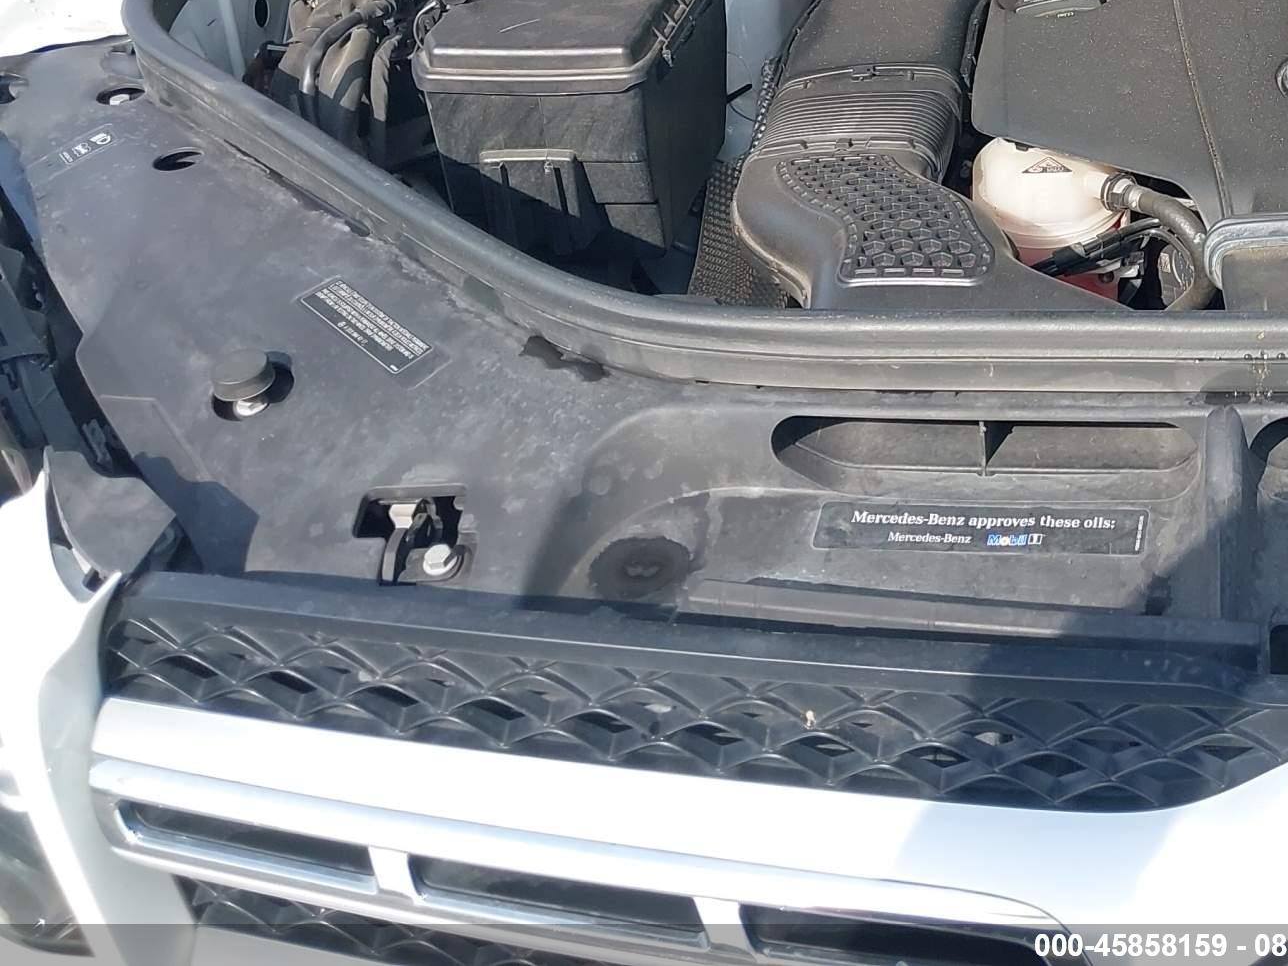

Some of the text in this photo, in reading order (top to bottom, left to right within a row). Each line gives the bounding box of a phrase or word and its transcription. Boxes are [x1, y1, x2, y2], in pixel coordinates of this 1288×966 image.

[851, 510, 1116, 530] Mercedes-Benz approves these oils:
[888, 531, 972, 544] Mercedes-Benz
